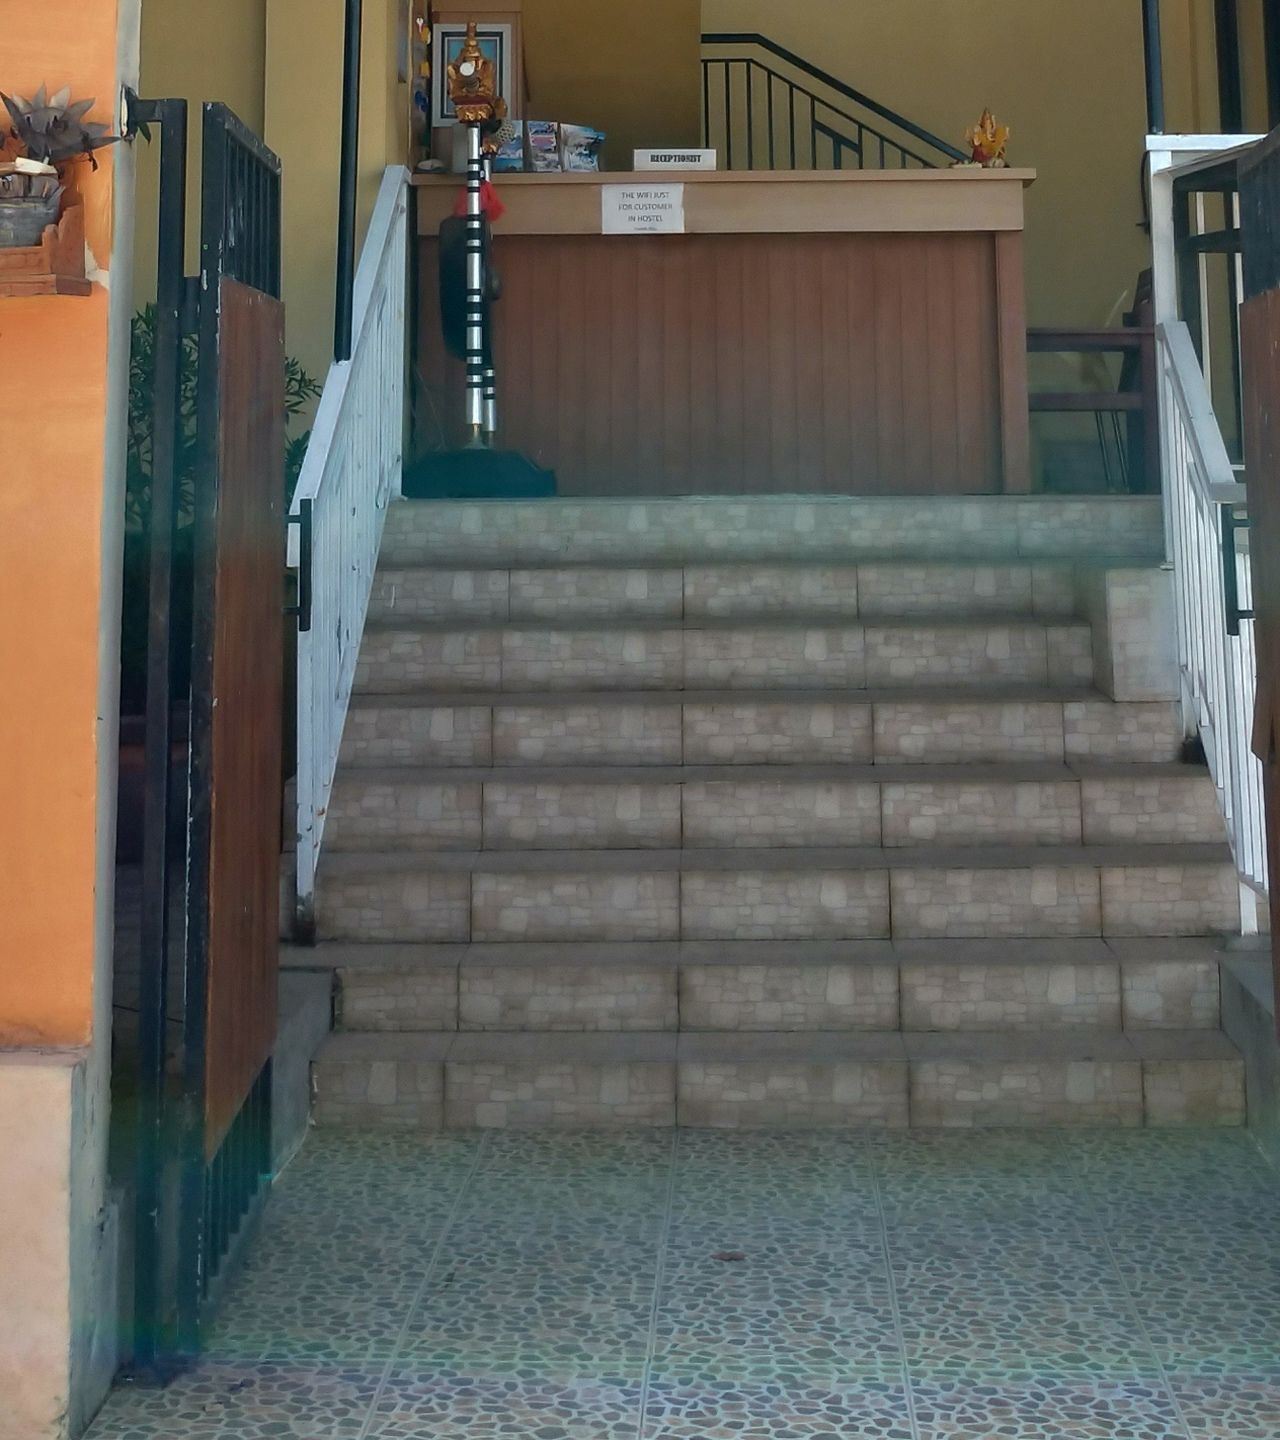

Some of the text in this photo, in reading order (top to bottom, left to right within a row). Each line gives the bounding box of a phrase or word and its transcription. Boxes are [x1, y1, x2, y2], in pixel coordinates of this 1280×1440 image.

[649, 154, 702, 163] RECEPTIONIST
[621, 191, 670, 199] THE WIFI JUST
[618, 203, 673, 211] FOR CUSTOMER
